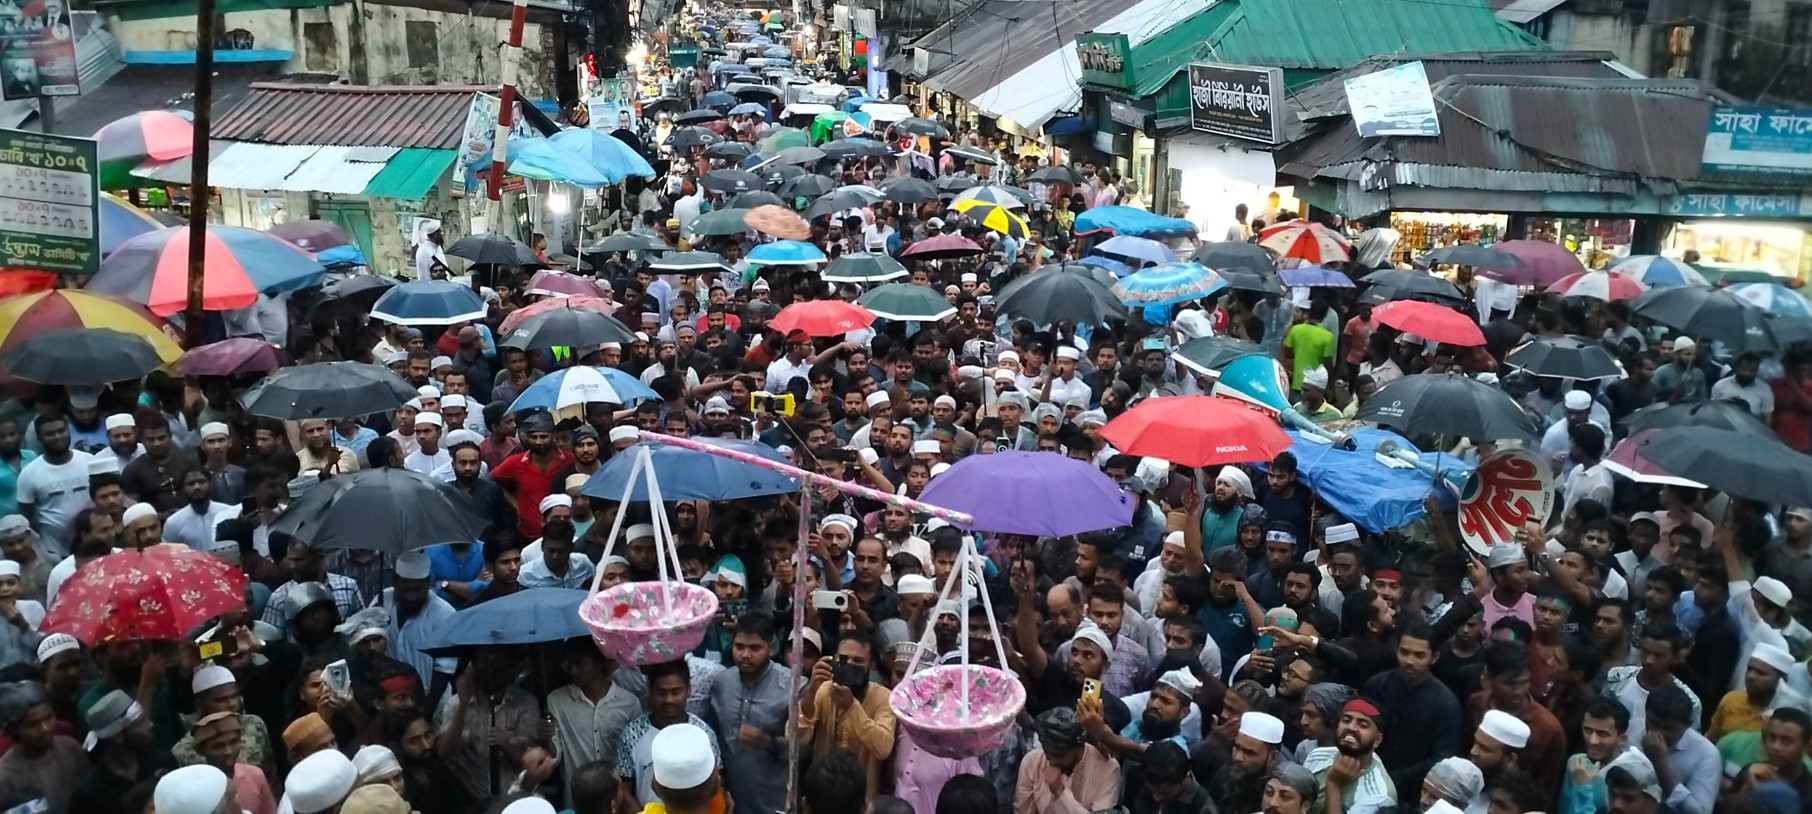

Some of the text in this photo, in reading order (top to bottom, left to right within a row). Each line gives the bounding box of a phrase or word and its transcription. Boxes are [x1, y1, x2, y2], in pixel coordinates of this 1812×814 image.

[1192, 78, 1271, 118] হাজী বিরিয়ানী হাউস
[1715, 112, 1762, 134] সাহা
[76, 156, 89, 172] ৭
[1687, 193, 1729, 212] সাহা
[1215, 445, 1249, 454] NOKIA
